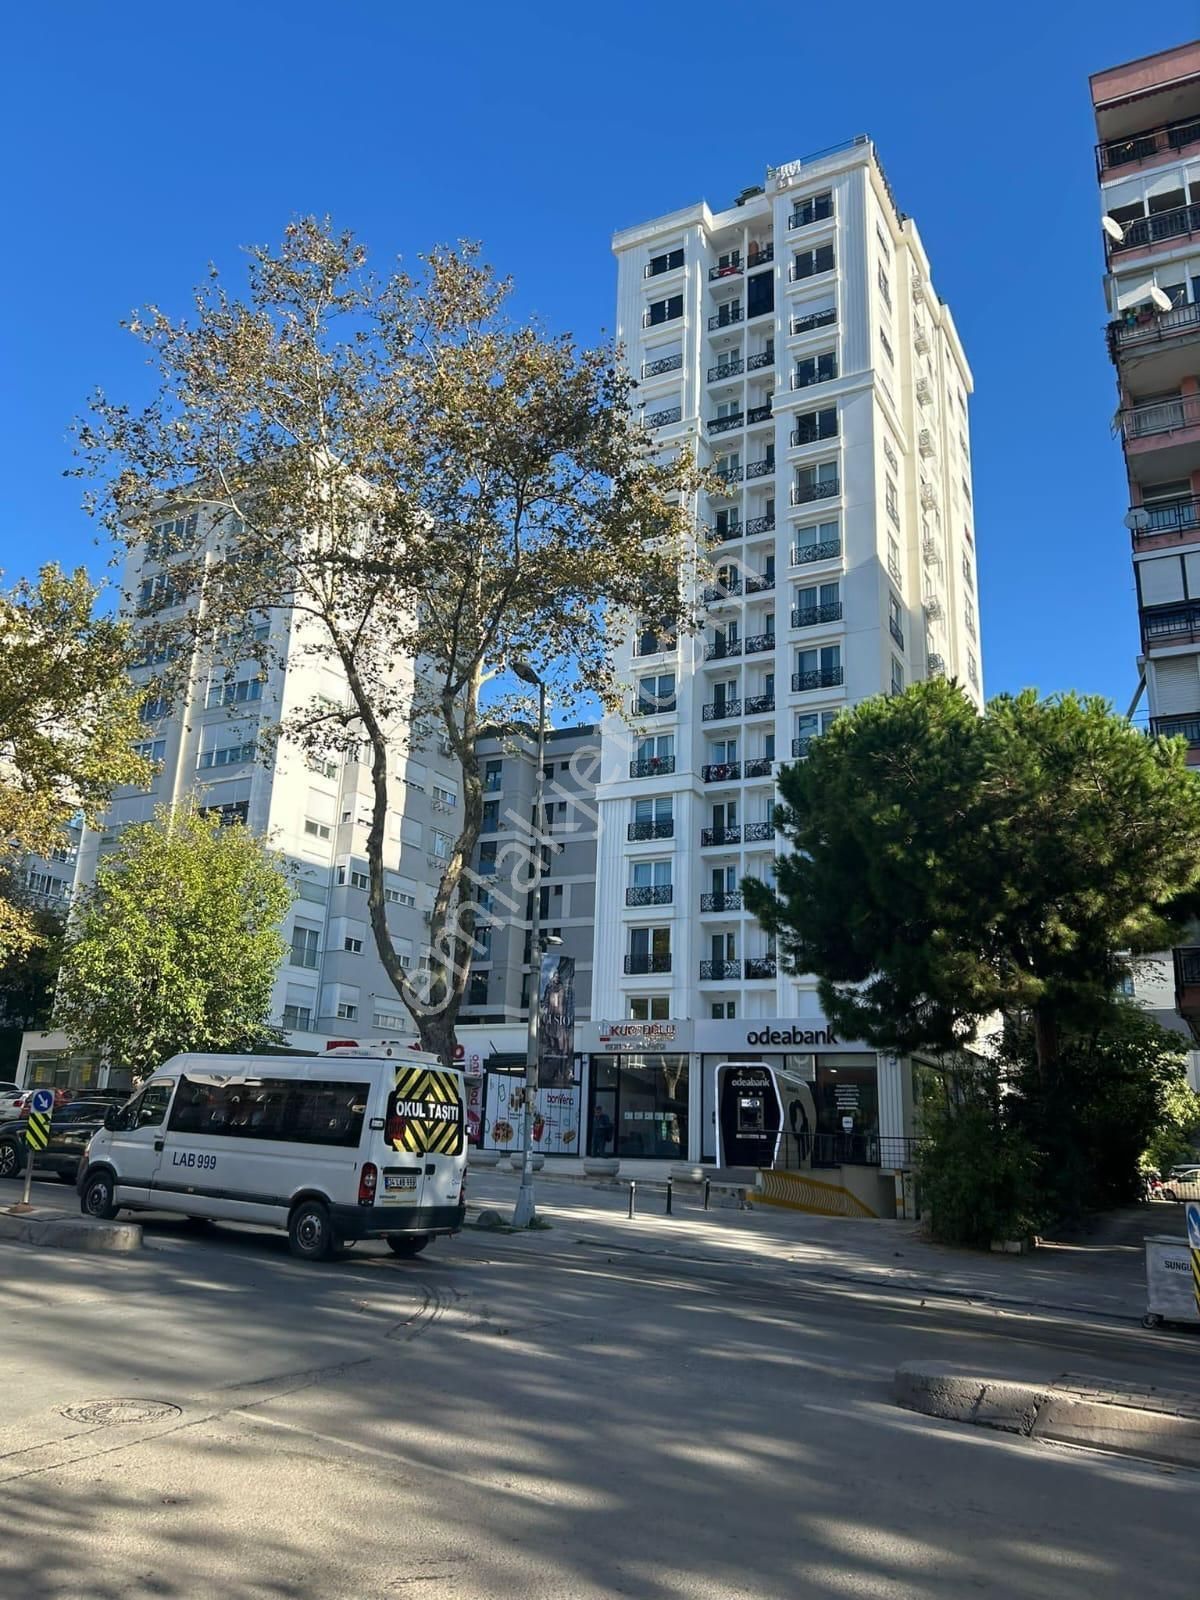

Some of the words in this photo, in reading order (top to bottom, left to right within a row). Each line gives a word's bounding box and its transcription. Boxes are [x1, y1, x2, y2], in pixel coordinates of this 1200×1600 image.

[747, 1025, 838, 1045] odeabank
[731, 1077, 770, 1087] odeabank
[396, 1101, 426, 1118] OKUL
[428, 1103, 459, 1121] TAŞITI
[173, 1152, 196, 1168] LAB
[197, 1154, 217, 1170] 999
